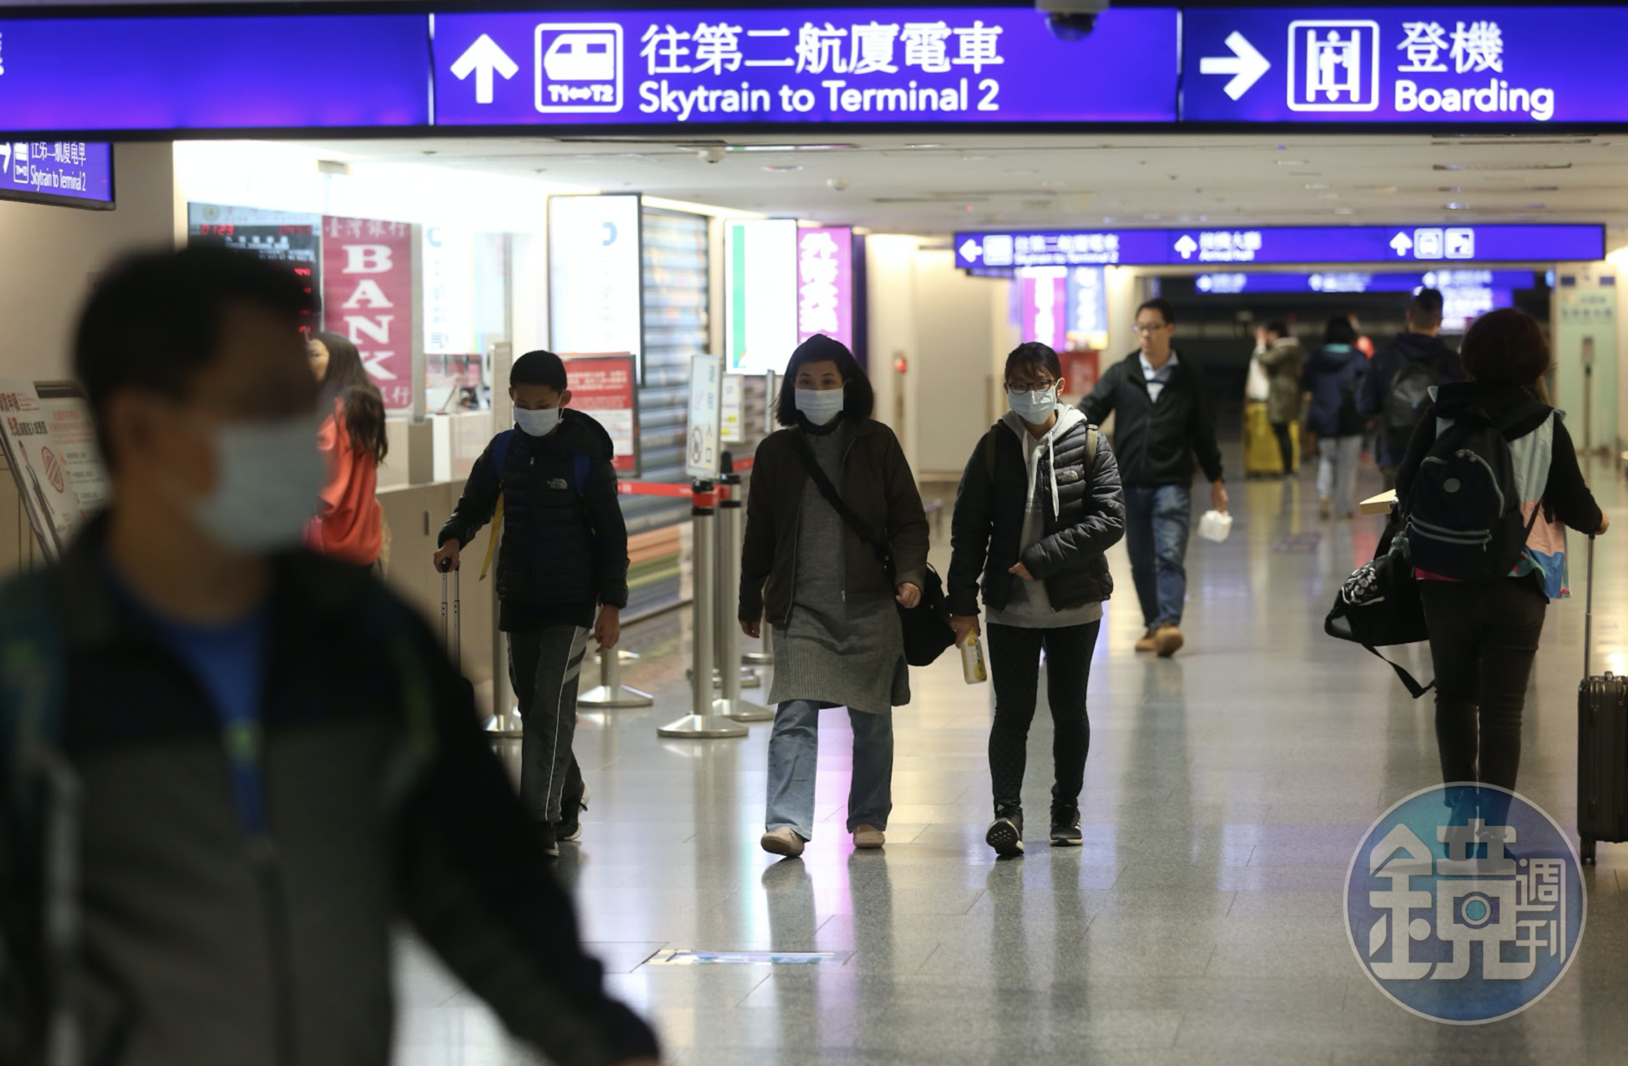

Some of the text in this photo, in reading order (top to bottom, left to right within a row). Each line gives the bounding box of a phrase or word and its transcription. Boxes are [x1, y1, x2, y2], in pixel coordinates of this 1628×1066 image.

[639, 20, 1005, 76] 往第二航廈電車
[1396, 20, 1504, 74] 登機
[639, 77, 999, 121] Skytrain to Terminal 2
[1394, 78, 1554, 121] Boarding
[341, 244, 398, 380] BANK
